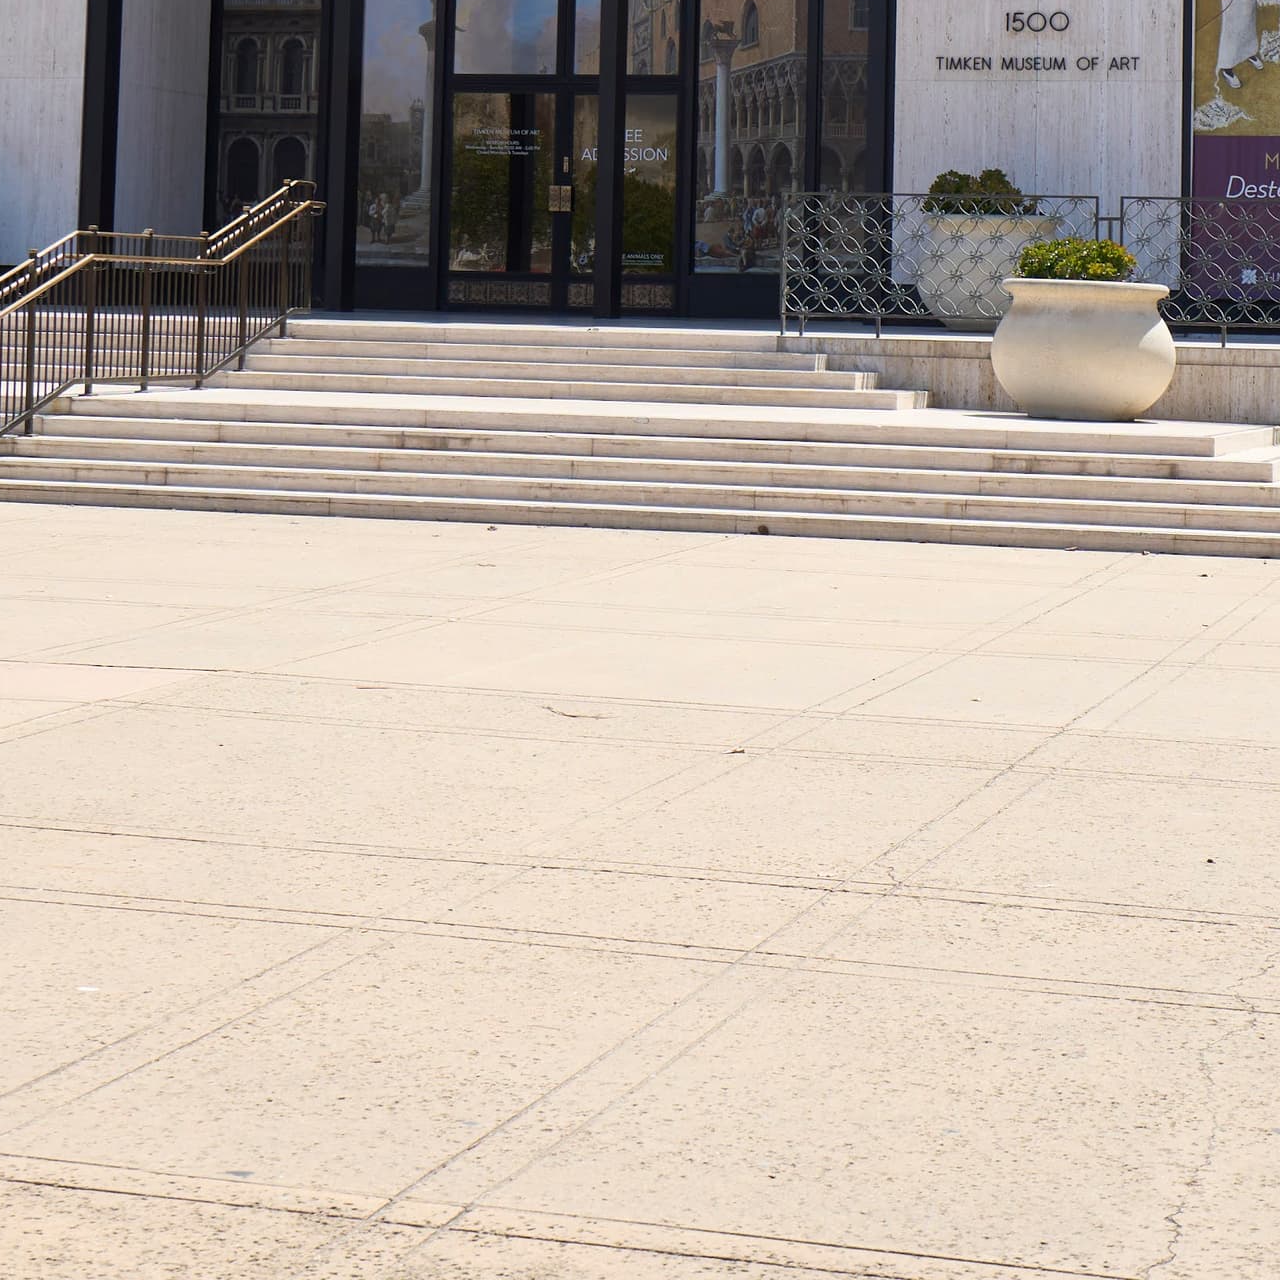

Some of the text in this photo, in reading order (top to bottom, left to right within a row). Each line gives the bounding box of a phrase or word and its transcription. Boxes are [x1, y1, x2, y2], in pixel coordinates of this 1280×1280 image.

[1005, 11, 1070, 32] 1500
[936, 56, 1141, 71] TIMKEN MUSEUM OF ART
[581, 147, 669, 161] ADSSION
